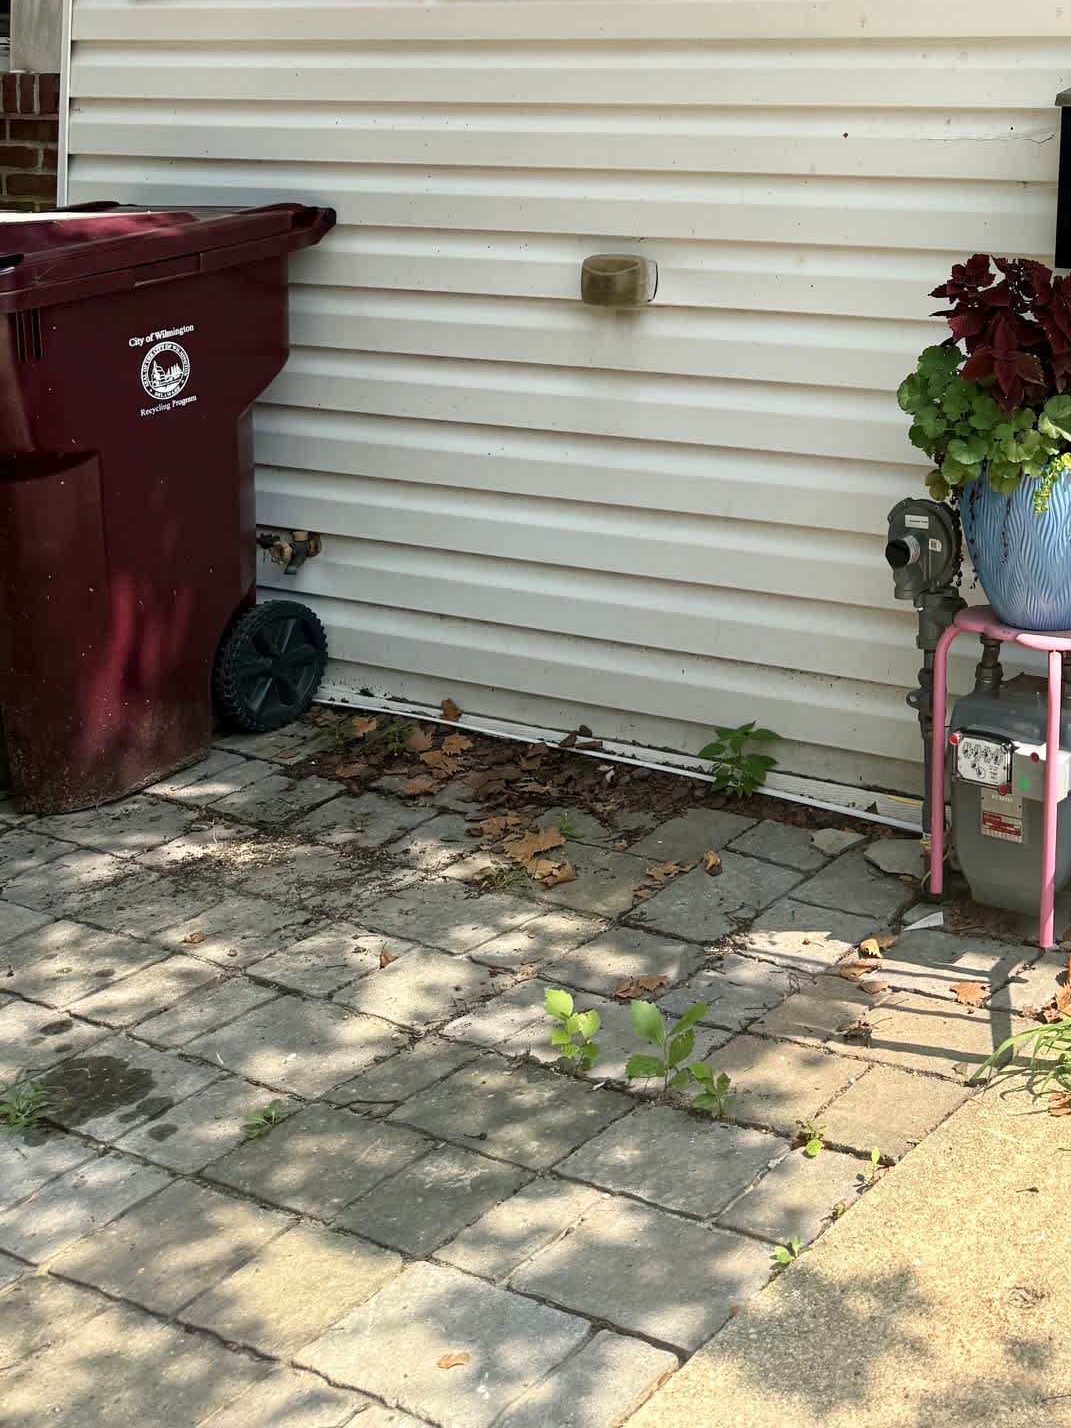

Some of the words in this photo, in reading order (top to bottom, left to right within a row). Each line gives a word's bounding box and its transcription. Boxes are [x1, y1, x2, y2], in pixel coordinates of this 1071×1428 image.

[129, 337, 144, 347] City
[146, 333, 154, 343] of
[155, 325, 194, 340] Wilmington
[140, 403, 171, 416] Recycling
[172, 395, 197, 407] Program
